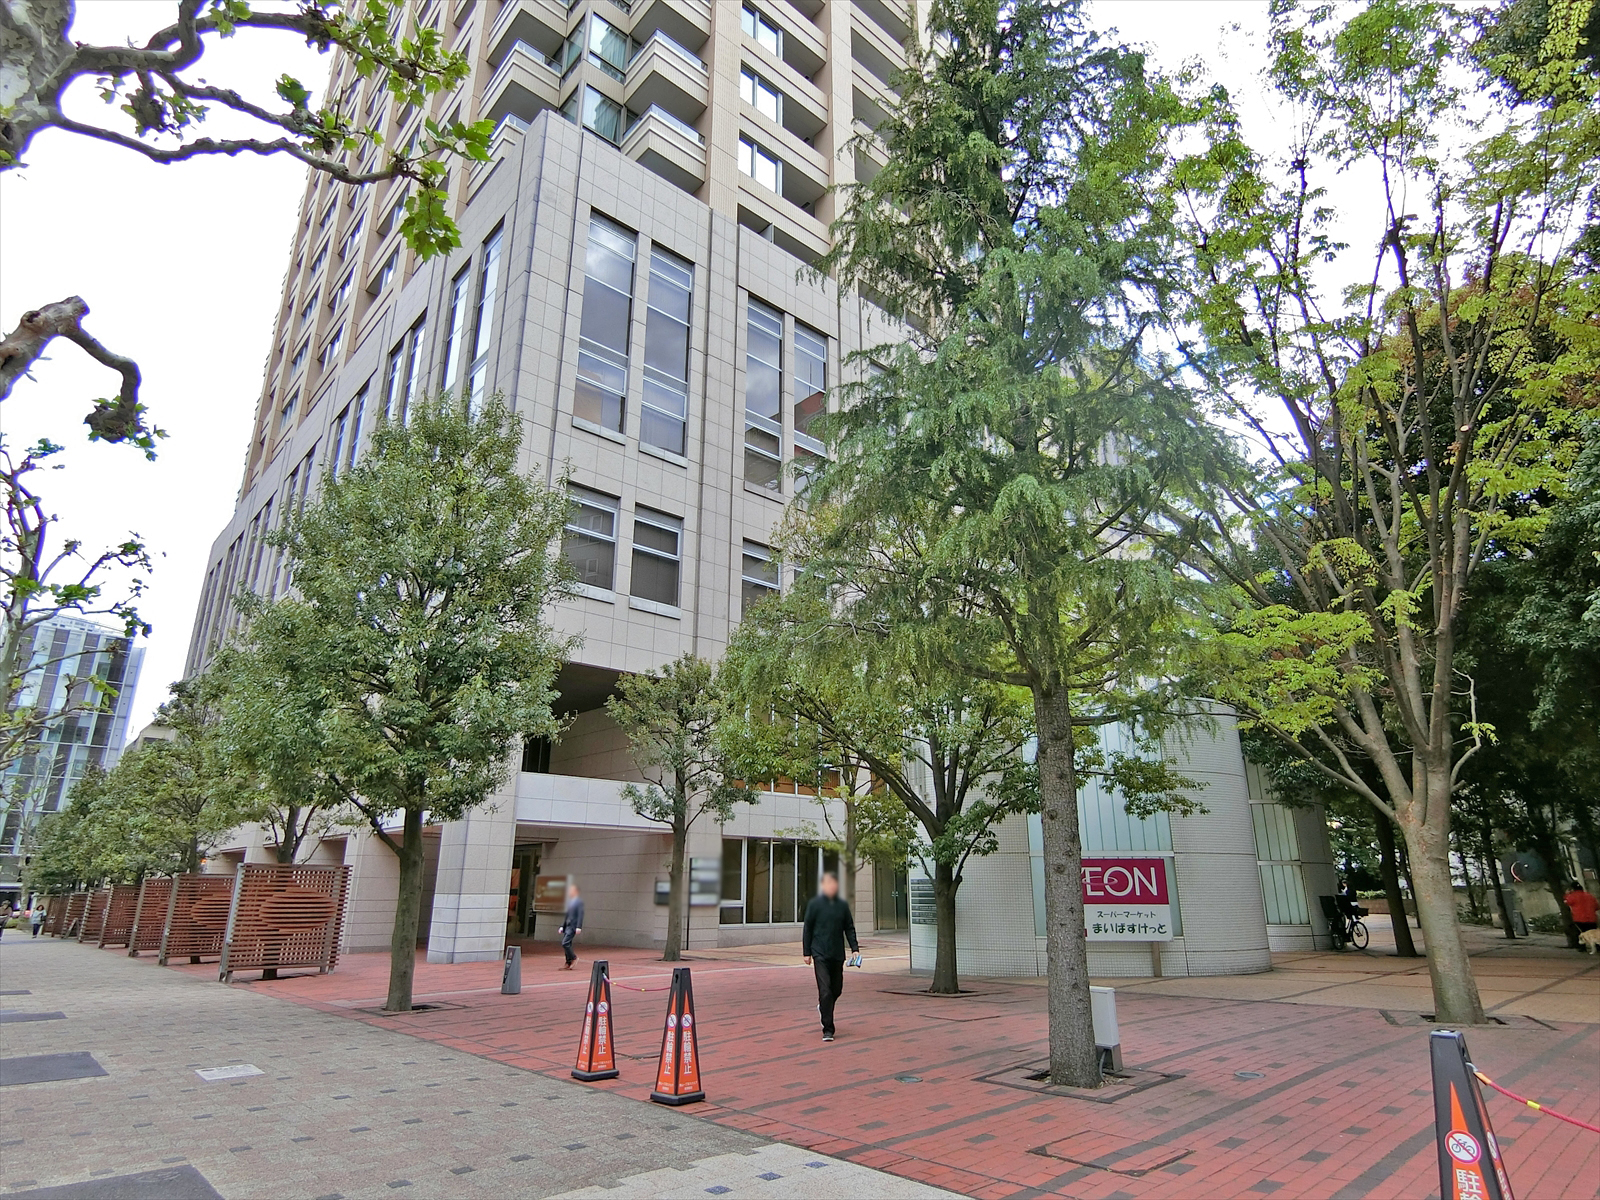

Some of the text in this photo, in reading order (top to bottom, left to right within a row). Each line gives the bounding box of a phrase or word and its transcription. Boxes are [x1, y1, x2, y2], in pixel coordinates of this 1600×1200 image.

[1081, 866, 1158, 896] EON
[1092, 923, 1167, 934] まいばすけっと
[598, 1016, 607, 1054] 駐輪禁止
[664, 1031, 674, 1074] 駐輪禁止
[683, 1031, 692, 1074] 駐輪禁止
